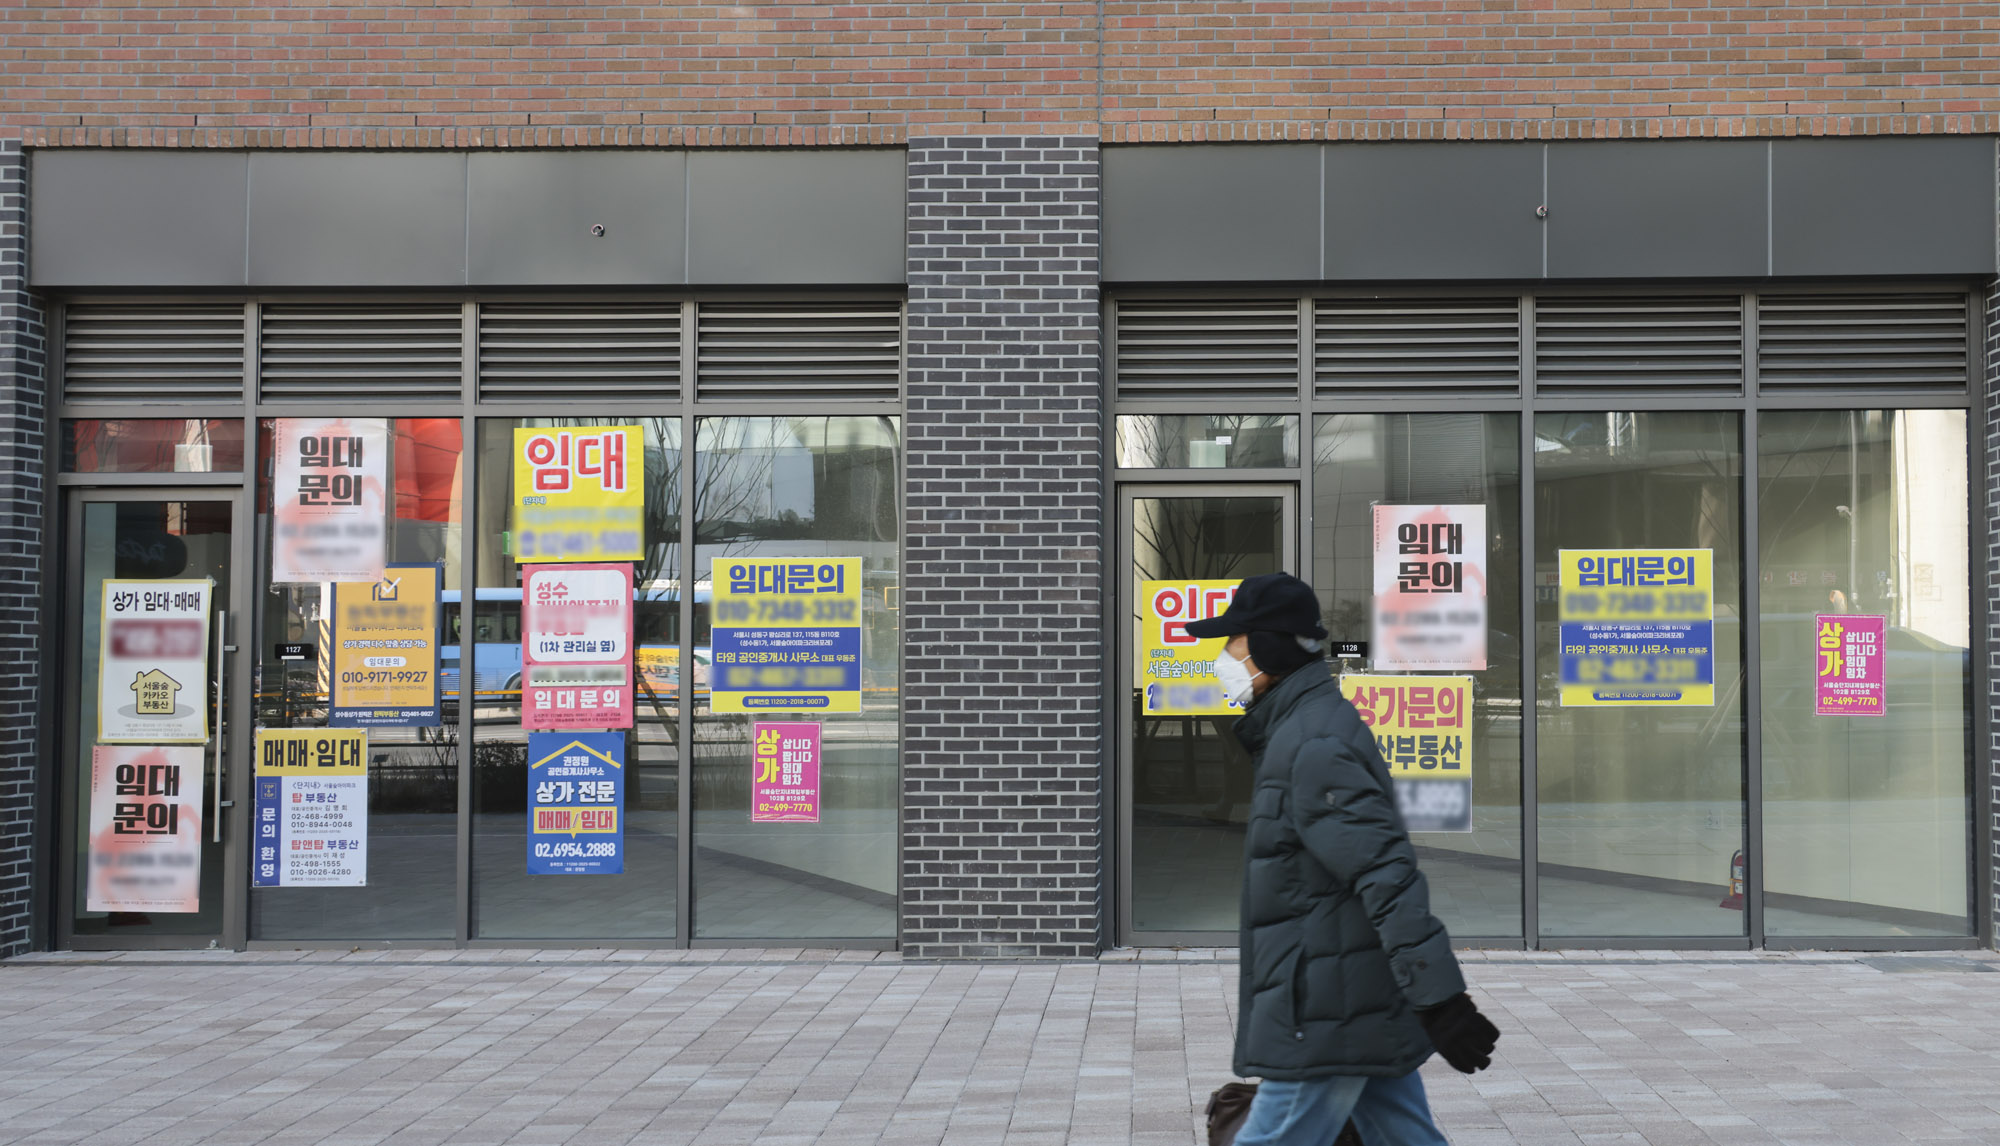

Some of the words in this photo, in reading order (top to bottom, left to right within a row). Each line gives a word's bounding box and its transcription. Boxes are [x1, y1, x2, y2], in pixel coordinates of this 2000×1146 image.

[300, 436, 363, 468] 임대
[527, 433, 624, 491] 임대
[298, 474, 362, 506] 문의
[1398, 523, 1462, 555] 임대
[1398, 561, 1462, 593] 문의
[1578, 556, 1694, 586] 임대문의
[730, 564, 844, 594] 임대문의
[536, 582, 568, 599] 성수
[113, 591, 139, 612] 상가
[144, 591, 200, 612] 임대·매매
[1846, 632, 1876, 643] 삽니다
[540, 641, 559, 653] (1차
[563, 640, 596, 652] 관리실
[600, 640, 615, 652] 옆)
[1819, 622, 1844, 676] 상가
[1846, 644, 1877, 656] 팝니다
[716, 652, 736, 663] 타임
[738, 652, 788, 663] 공인중개사
[790, 652, 820, 662] 사무소
[1150, 649, 1175, 658] (단지내)
[1846, 656, 1866, 667] 임대
[342, 671, 428, 683] 010-9171-9927
[1846, 668, 1866, 679] 임차
[143, 682, 169, 691] 서울숲
[143, 691, 169, 700] 카카오
[534, 689, 620, 709] 임대문의
[1823, 696, 1877, 706] 02-499-7770
[143, 700, 169, 709] 부동산
[1350, 686, 1464, 728] 상가문의
[783, 739, 812, 749] 삽니다
[264, 739, 360, 767] 매매·임대
[757, 730, 781, 783] 상가
[783, 751, 812, 762] 팝니다
[563, 756, 589, 766] 권정원
[548, 767, 605, 776] 공인중개사사무소
[783, 763, 802, 773] 임대
[116, 764, 180, 796] 임대
[782, 774, 802, 785] 임차
[292, 793, 302, 803] 탑
[305, 793, 337, 803] 부동산
[536, 781, 574, 803] 상가
[578, 781, 616, 803] 전문
[760, 803, 812, 812] 02-499-7770
[113, 803, 178, 834] 문의
[538, 810, 613, 829] 매매/임대
[292, 840, 324, 850] 탑앤탑
[327, 840, 359, 850] 부동산
[535, 842, 616, 858] 02.6954.2888
